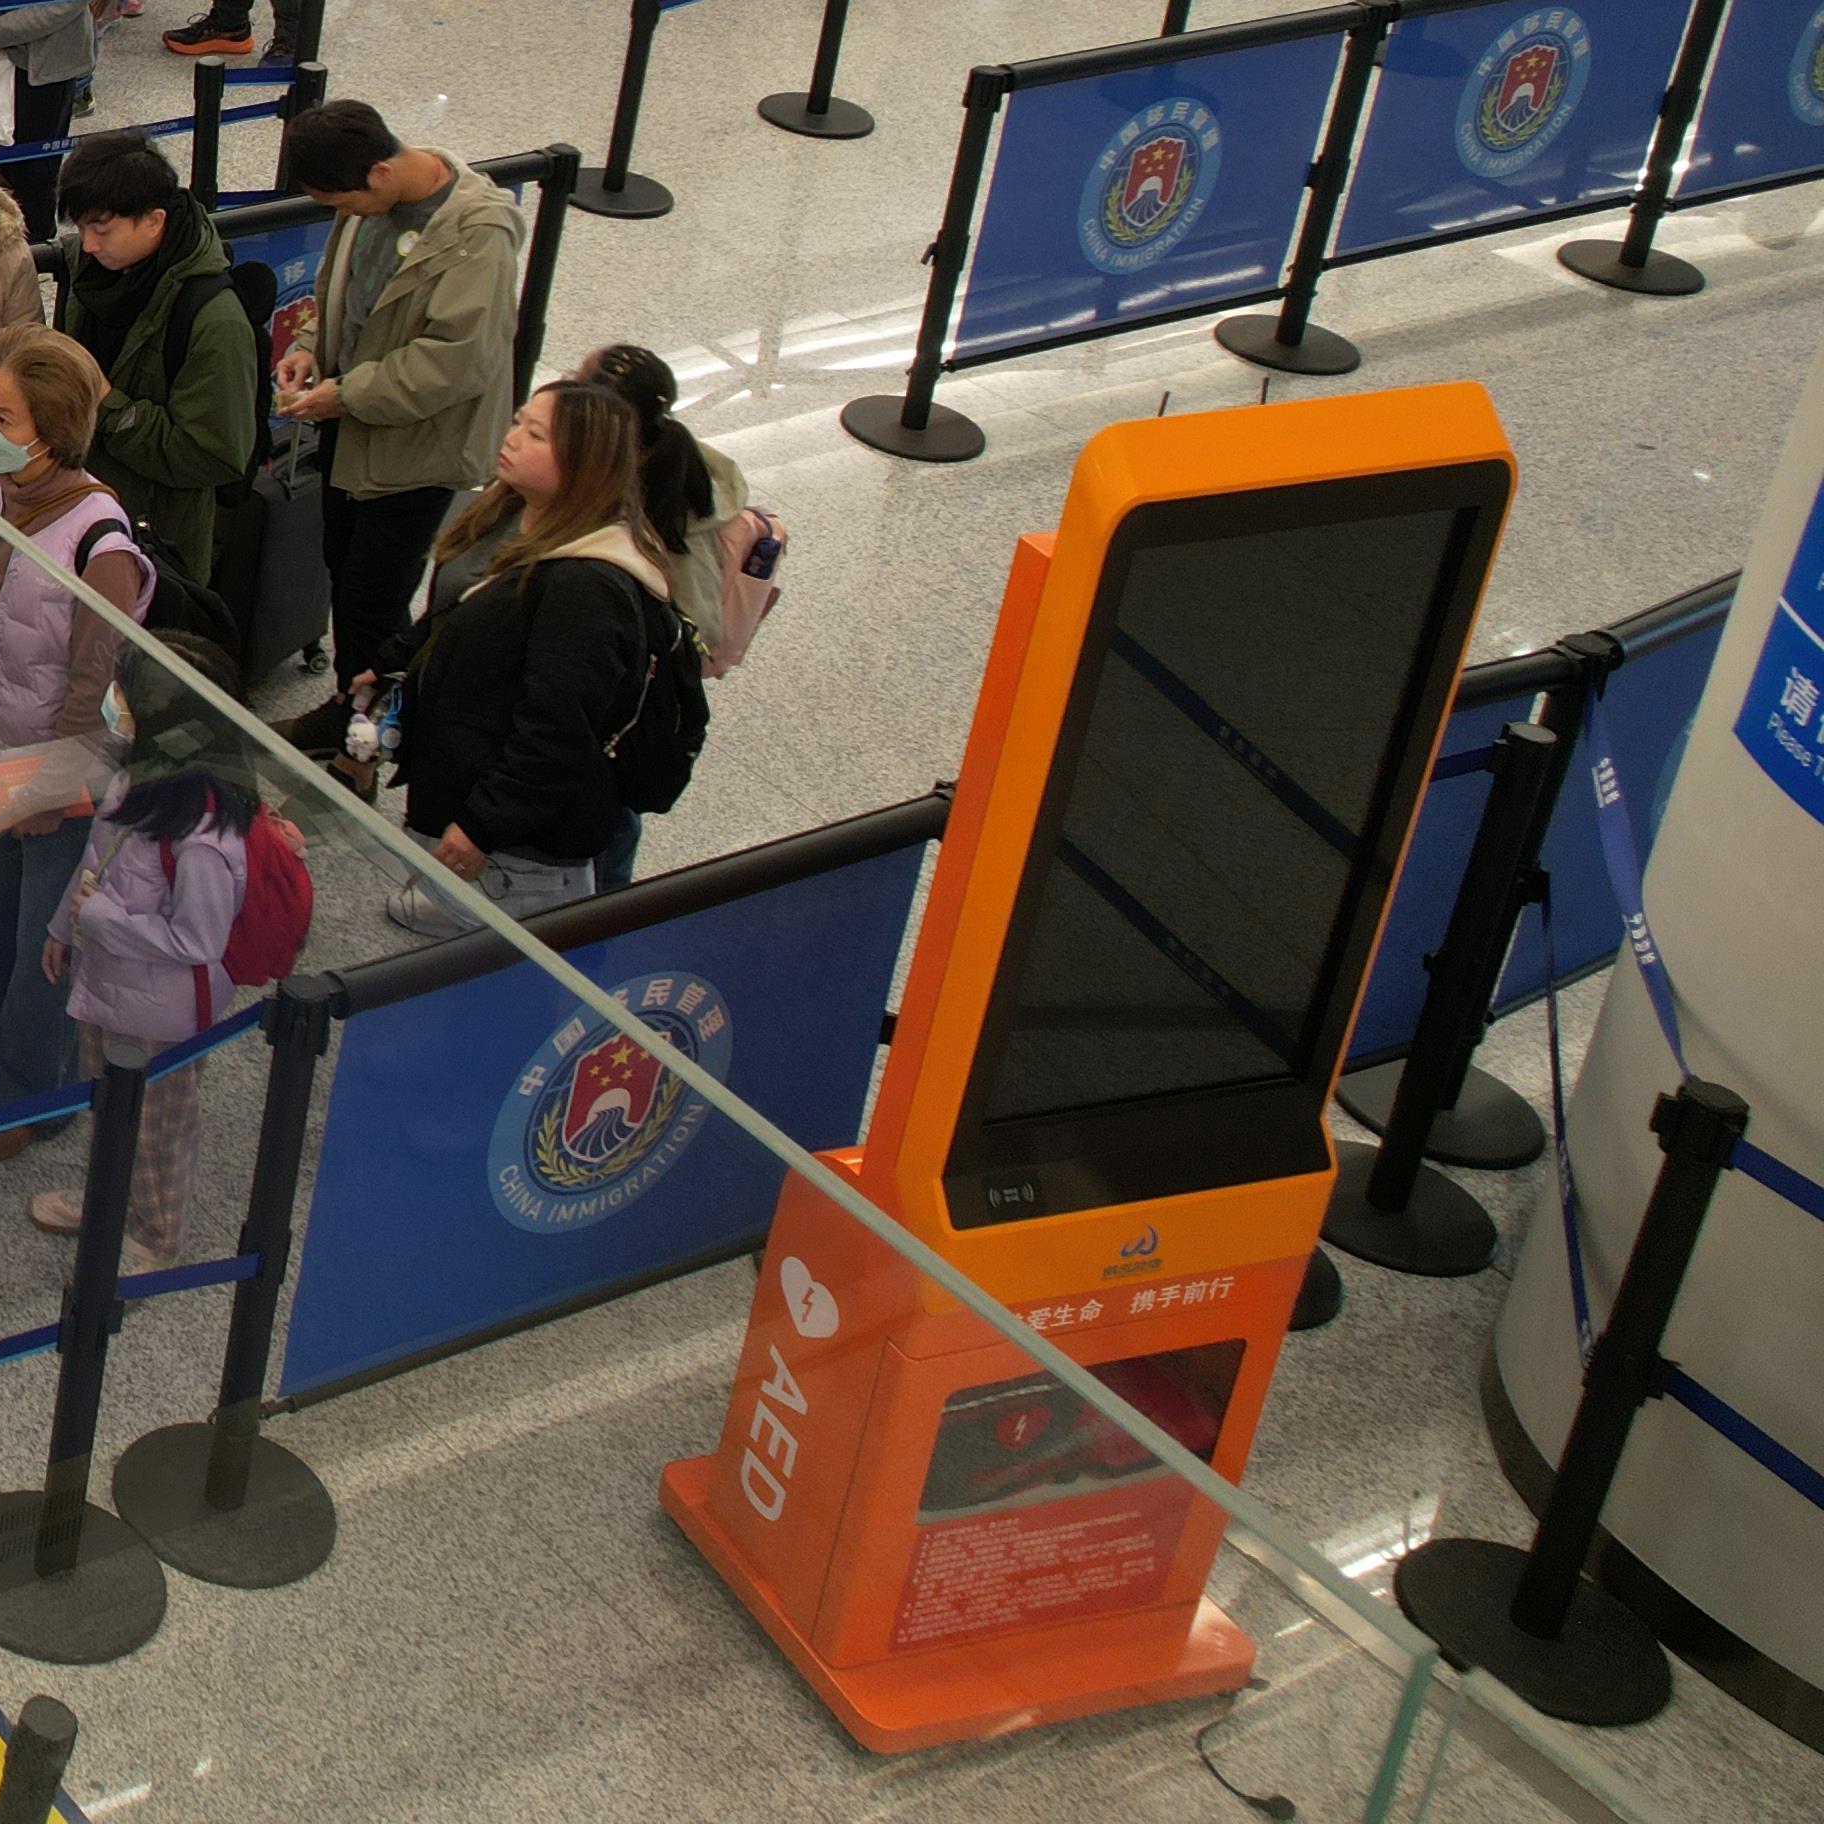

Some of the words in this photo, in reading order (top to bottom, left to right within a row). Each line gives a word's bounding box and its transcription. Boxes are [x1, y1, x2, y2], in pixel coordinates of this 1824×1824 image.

[1475, 6, 1591, 81] 中国移民管理
[1099, 99, 1222, 172] 中国移民管理
[1460, 121, 1482, 166] CHINA
[1485, 103, 1573, 170] IMMIGRATION
[1083, 216, 1110, 261] CHINA
[1110, 195, 1204, 269] IMMIGRATION
[1765, 711, 1814, 768] Please
[498, 1163, 543, 1221] CHINA
[546, 1103, 705, 1225] IMMIGRATION
[1012, 1296, 1105, 1330] 爱生命
[1129, 1276, 1235, 1315] 携手前行
[738, 1342, 813, 1523] AED
